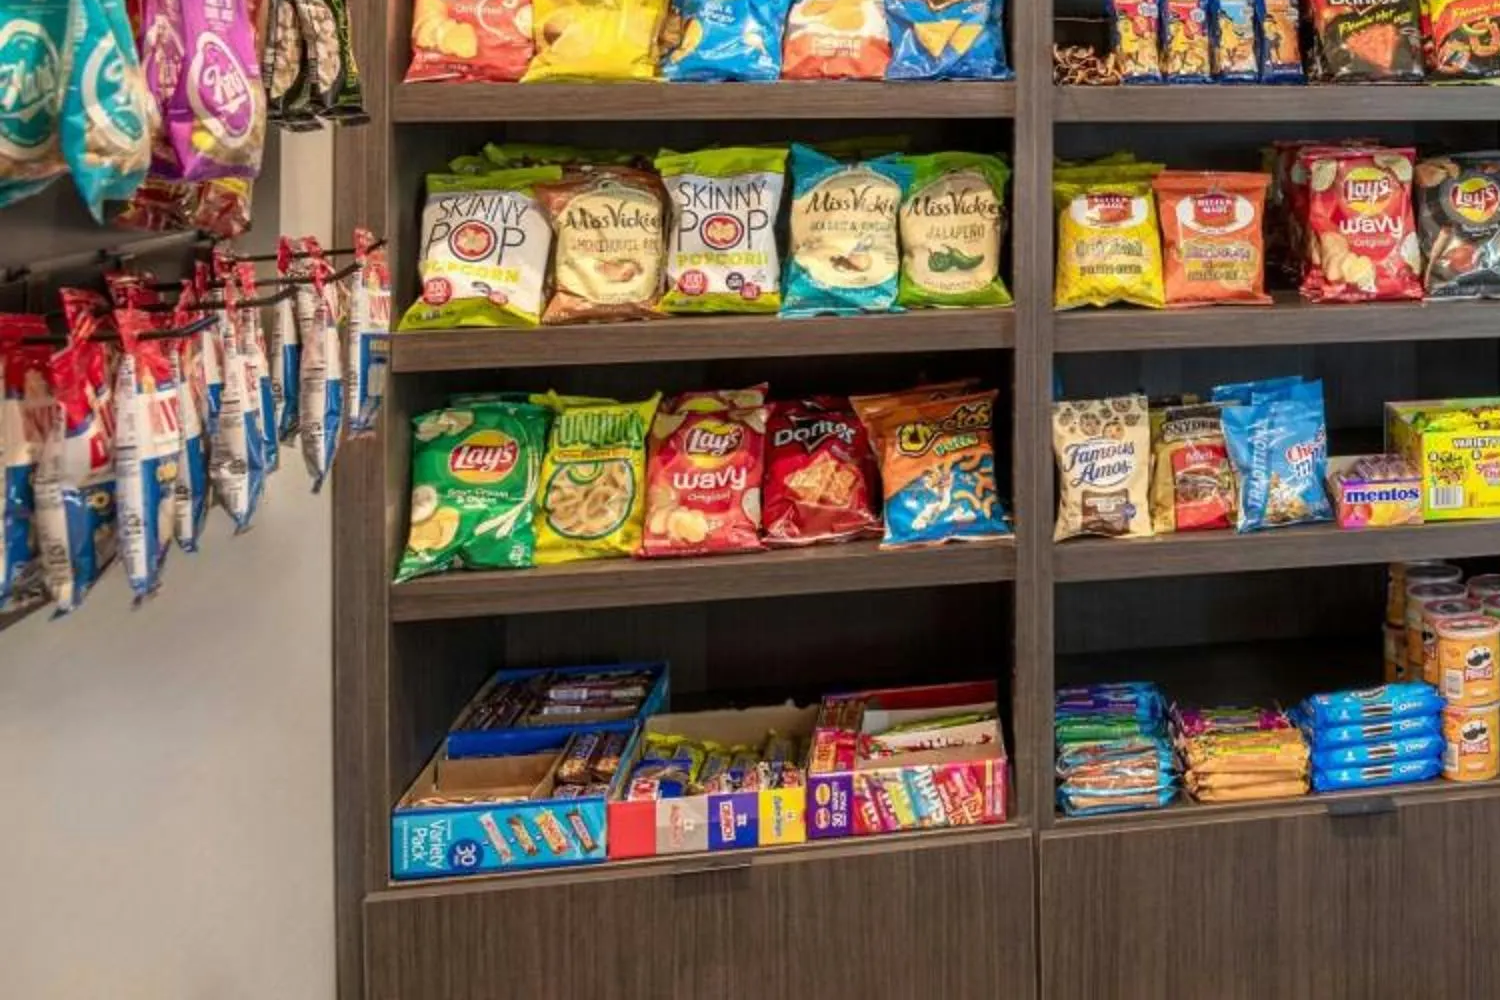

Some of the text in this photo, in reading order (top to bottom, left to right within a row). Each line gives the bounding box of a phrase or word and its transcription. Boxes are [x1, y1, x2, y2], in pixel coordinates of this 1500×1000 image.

[678, 179, 768, 210] SKINNY
[804, 191, 852, 214] Miss
[906, 196, 951, 217] Miss
[437, 193, 530, 227] SKINNY
[678, 209, 769, 250] POP
[1339, 216, 1403, 237] wavy
[424, 218, 527, 267] POP
[675, 251, 769, 266] POPCORN
[774, 419, 856, 447] Doritos
[1064, 440, 1135, 472] Famous
[673, 466, 748, 490] wavy
[1071, 462, 1132, 487] Amos
[1346, 486, 1420, 504] mentos
[411, 827, 428, 862] Pack
[426, 819, 447, 869] Variety
